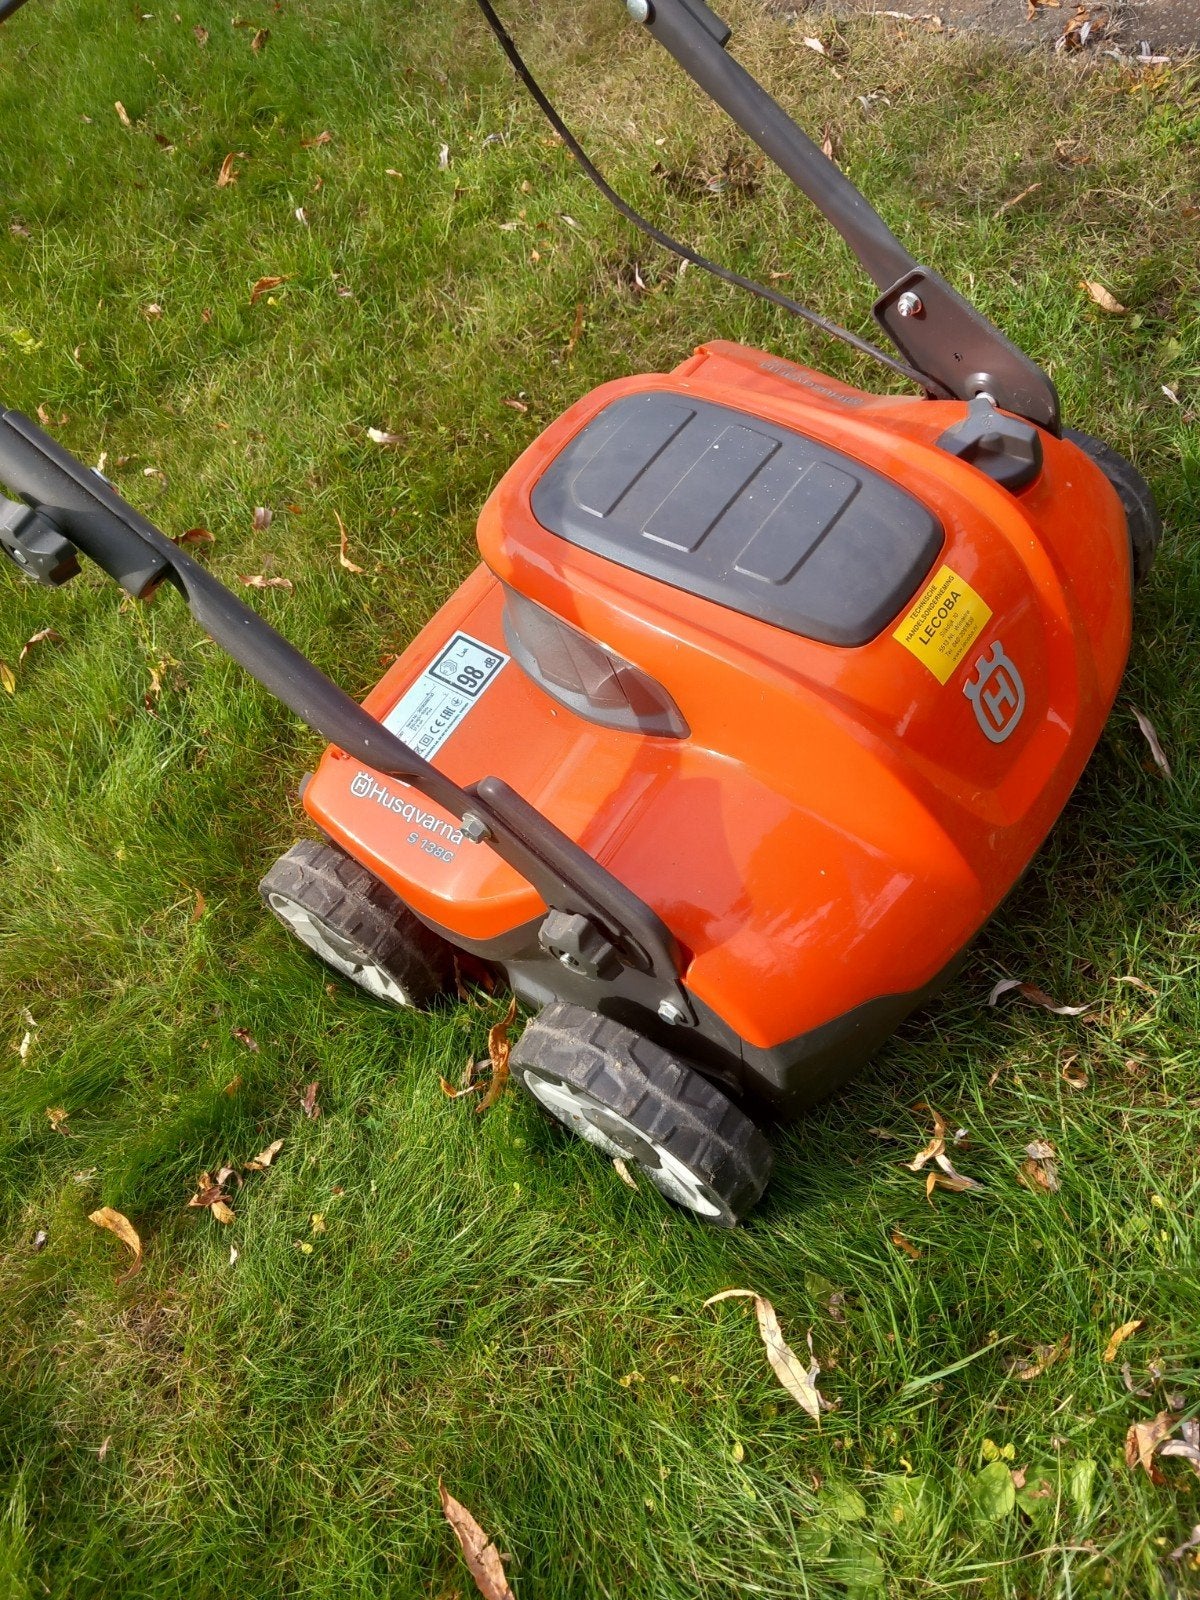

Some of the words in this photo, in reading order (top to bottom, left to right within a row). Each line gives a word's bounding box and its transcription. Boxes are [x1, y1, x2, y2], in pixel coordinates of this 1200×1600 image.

[905, 575, 955, 642] HANDELSONDERNEMING
[910, 585, 937, 620] TECHNISCHE
[918, 590, 961, 645] LECOBA
[457, 666, 484, 688] 98
[484, 657, 497, 668] dB
[369, 783, 463, 844] Husqvarna
[407, 832, 418, 844] S
[420, 839, 454, 862] 138C
